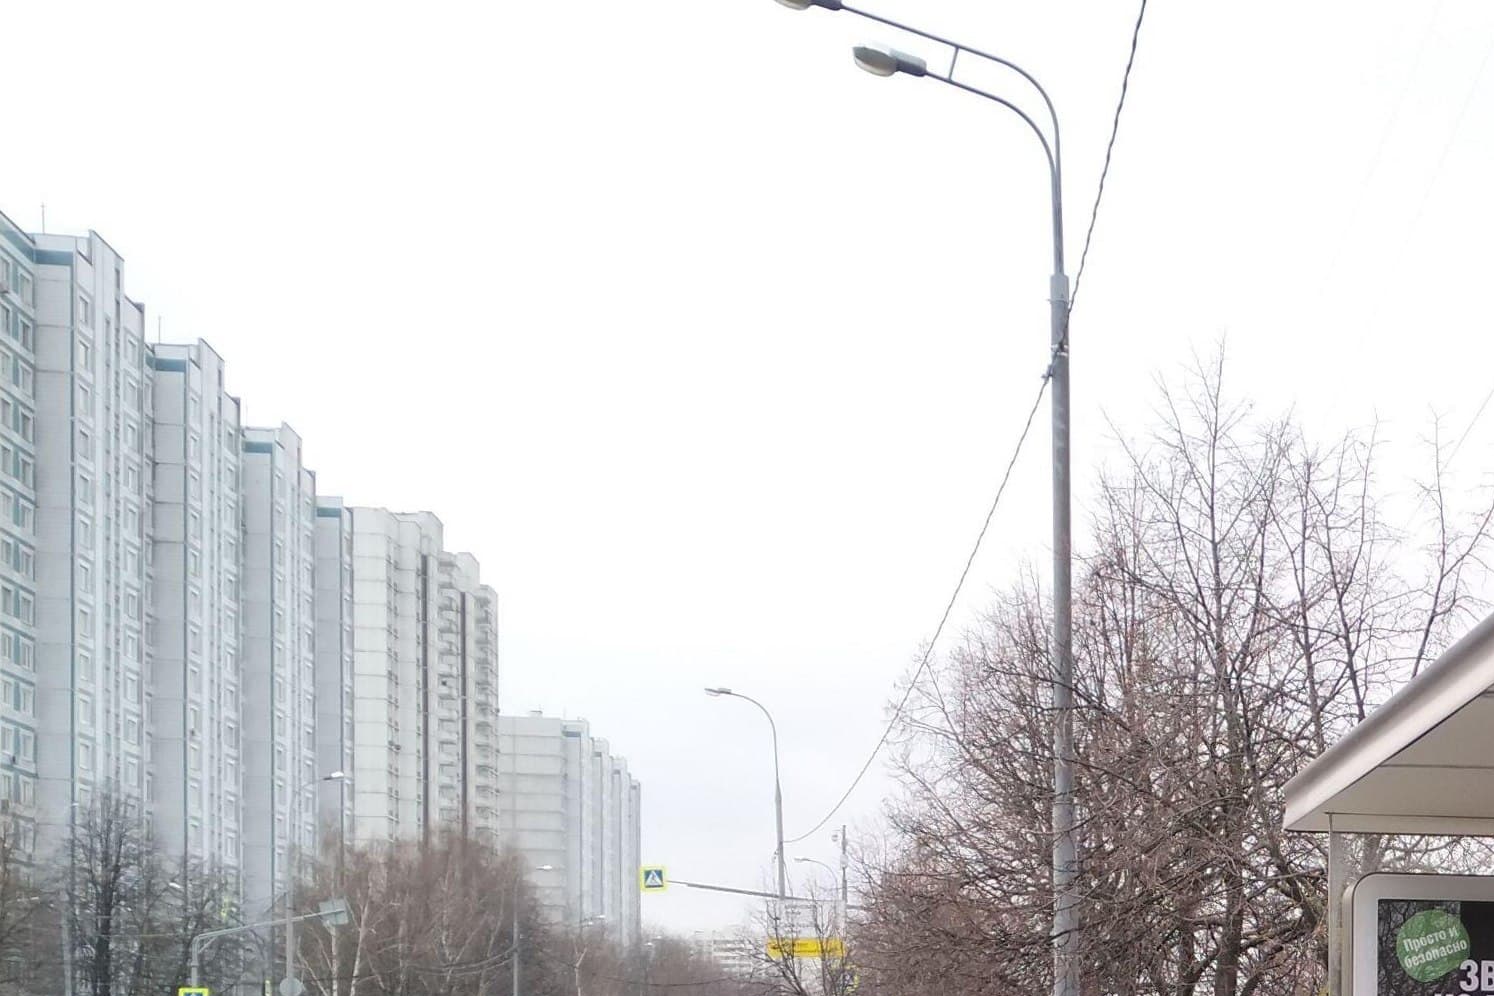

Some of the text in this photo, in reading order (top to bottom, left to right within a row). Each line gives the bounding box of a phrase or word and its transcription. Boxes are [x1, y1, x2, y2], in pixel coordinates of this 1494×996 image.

[1403, 925, 1459, 954] Просто и
[1403, 938, 1468, 969] безопасно
